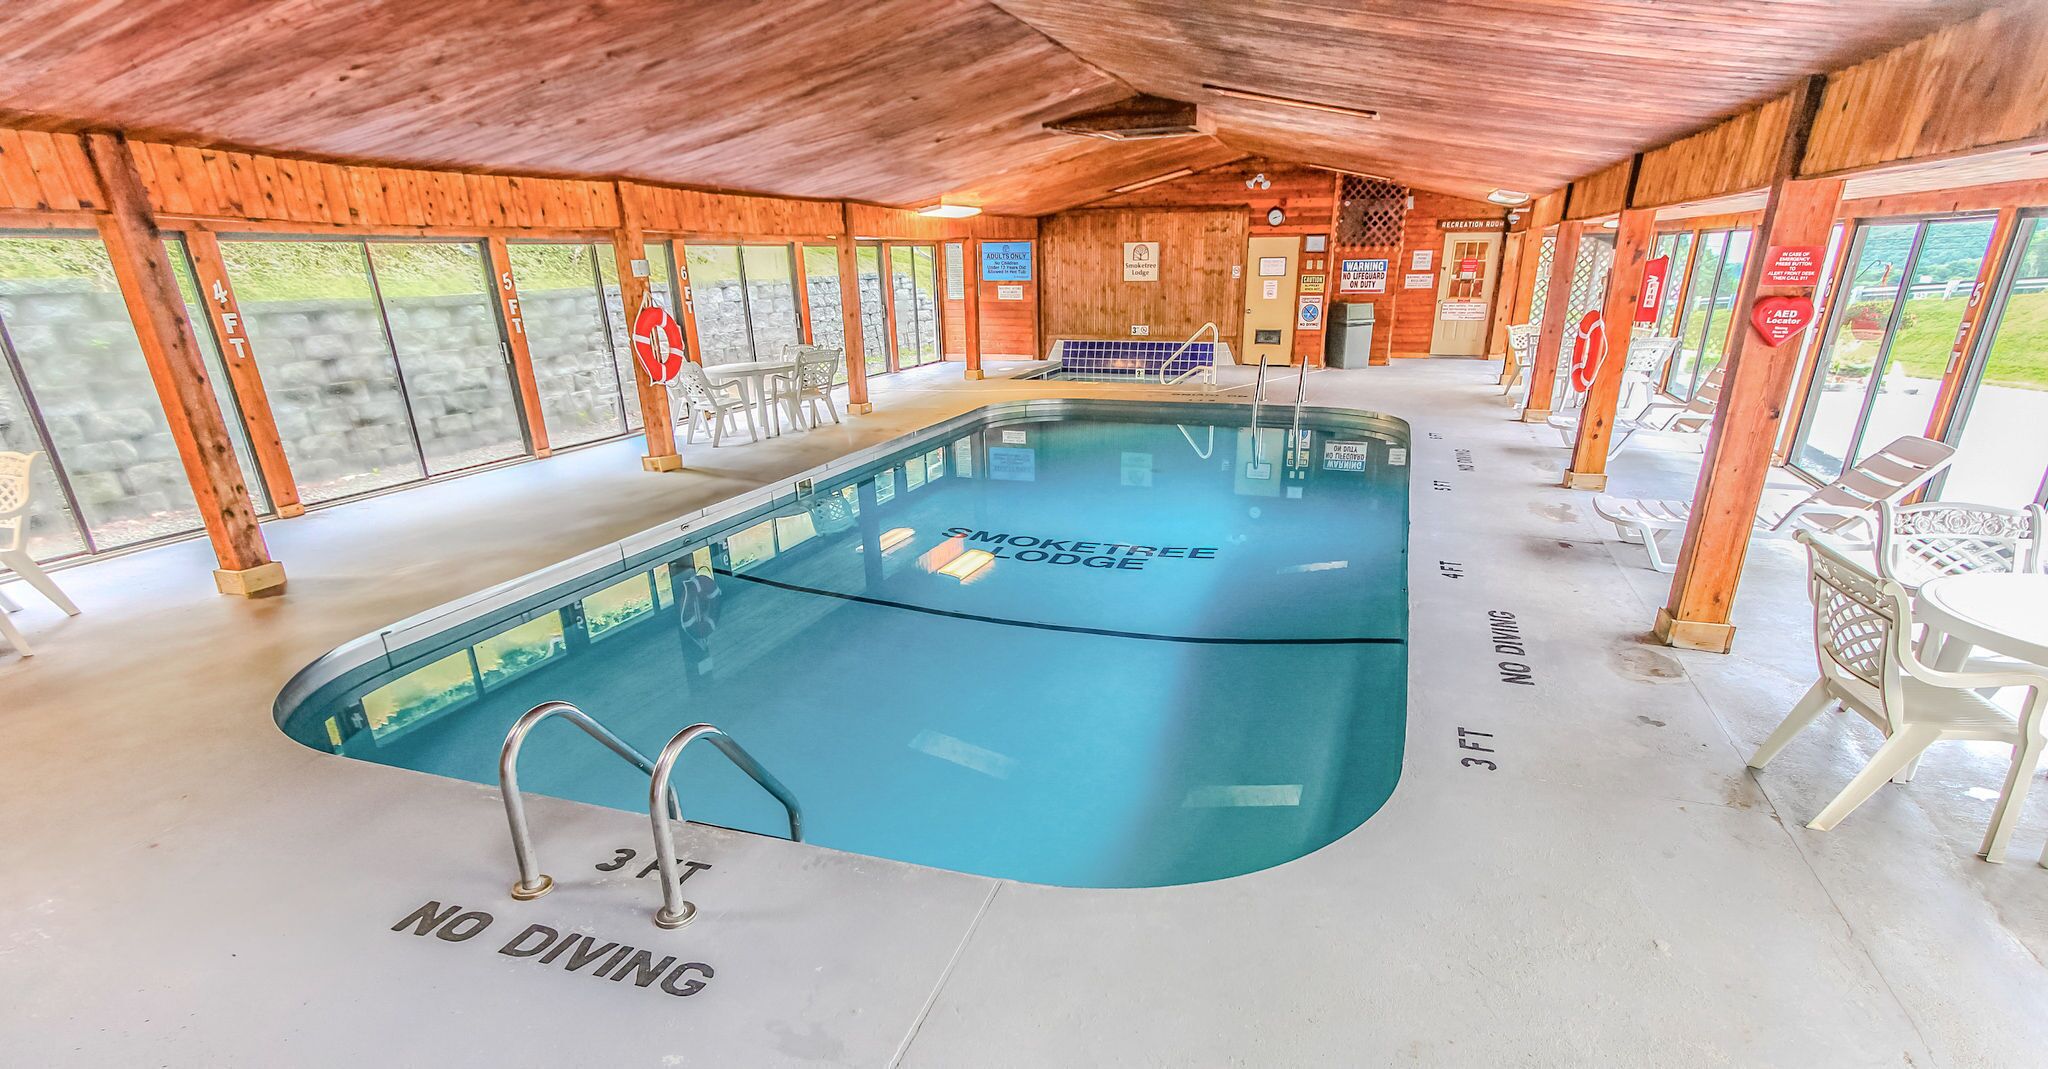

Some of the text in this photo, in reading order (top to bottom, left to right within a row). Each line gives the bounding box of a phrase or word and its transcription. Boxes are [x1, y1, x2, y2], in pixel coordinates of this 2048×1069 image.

[1485, 220, 1505, 228] ROOM
[1342, 272, 1385, 280] NO LIFEGUARD
[1346, 261, 1384, 271] WARNING
[502, 271, 522, 334] 5 FT
[682, 265, 693, 314] 6 FT
[213, 279, 245, 359] 4 FT
[1773, 310, 1798, 318] AED
[1946, 282, 1985, 374] 5 FT
[941, 527, 1219, 559] SMOKETREE
[992, 546, 1149, 570] LODGE
[1439, 560, 1463, 572] FT
[1487, 610, 1536, 686] NO DIVING
[1457, 726, 1497, 771] 3 FT
[594, 848, 637, 872] 3
[390, 900, 715, 997] NO DIVING
